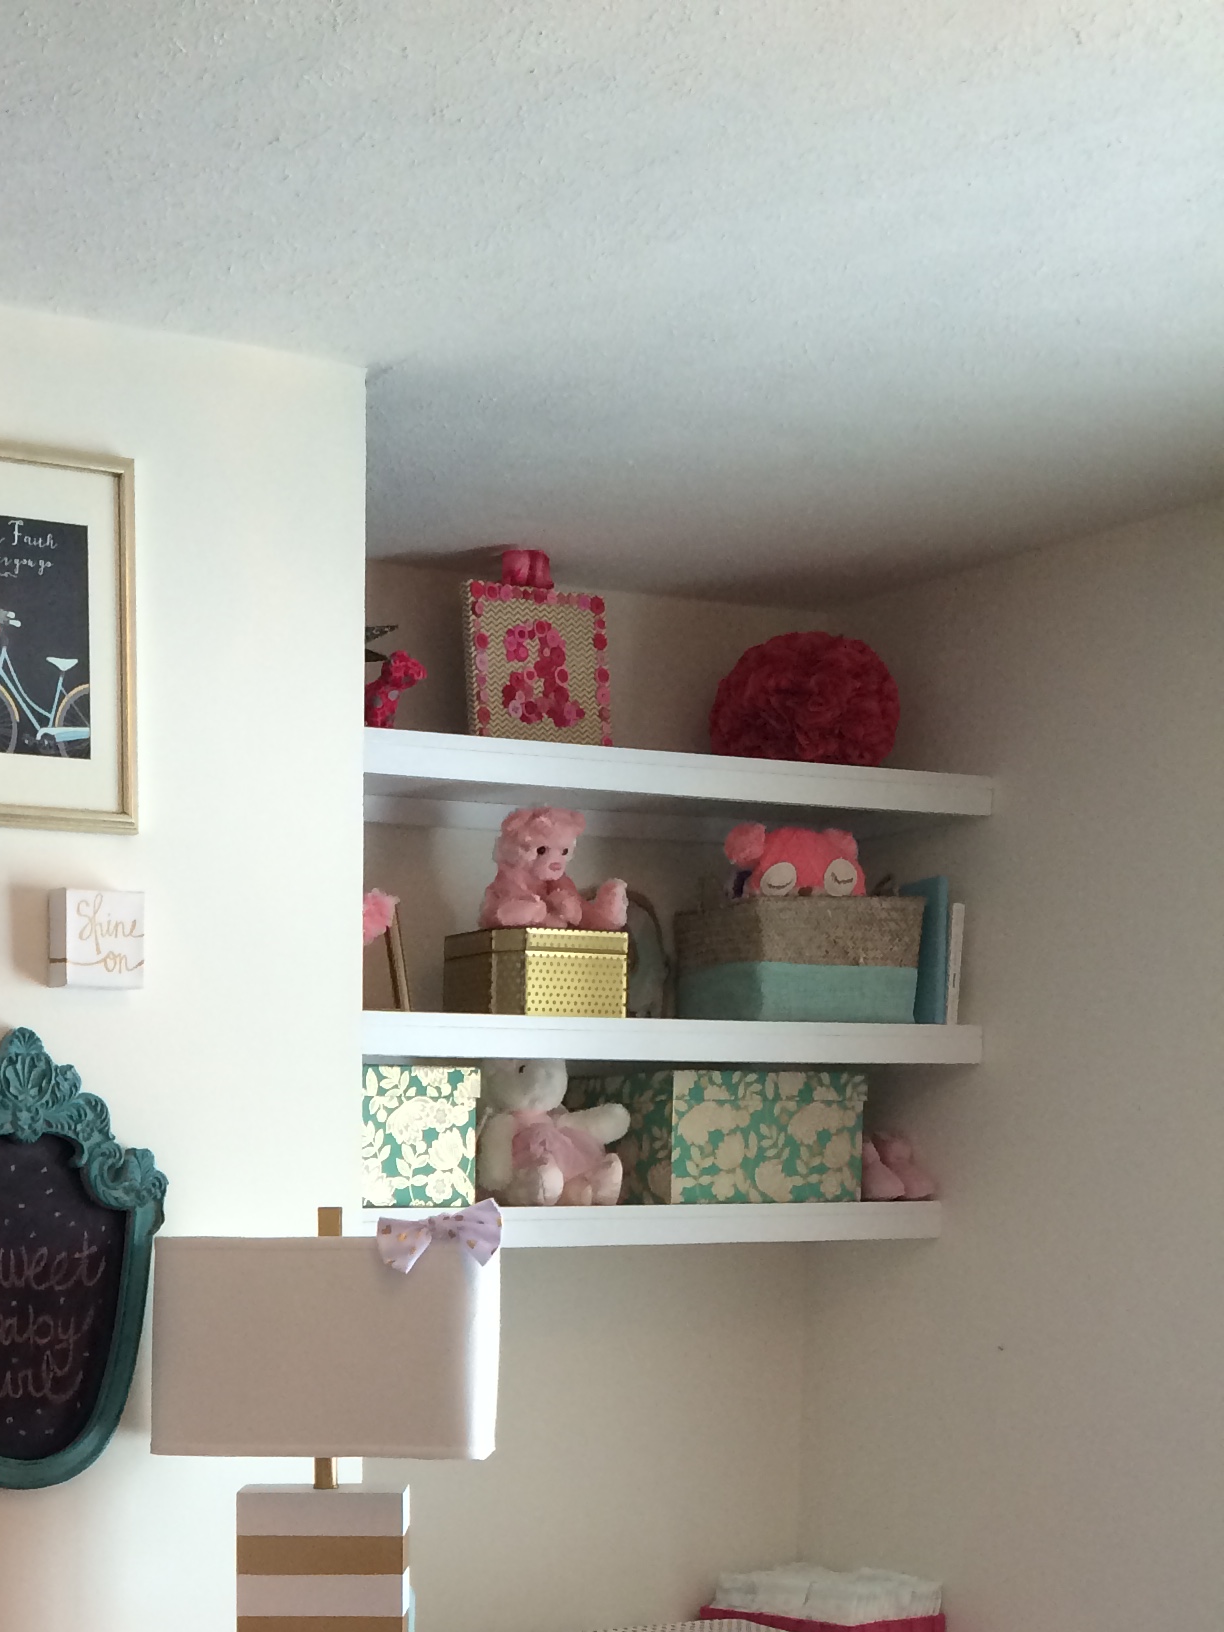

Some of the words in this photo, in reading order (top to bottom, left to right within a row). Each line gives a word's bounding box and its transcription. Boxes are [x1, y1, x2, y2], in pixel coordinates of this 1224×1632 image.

[8, 520, 57, 549] Faith
[13, 558, 35, 574] you
[38, 559, 54, 576] go
[76, 893, 144, 955] Shine
[91, 951, 144, 974] on
